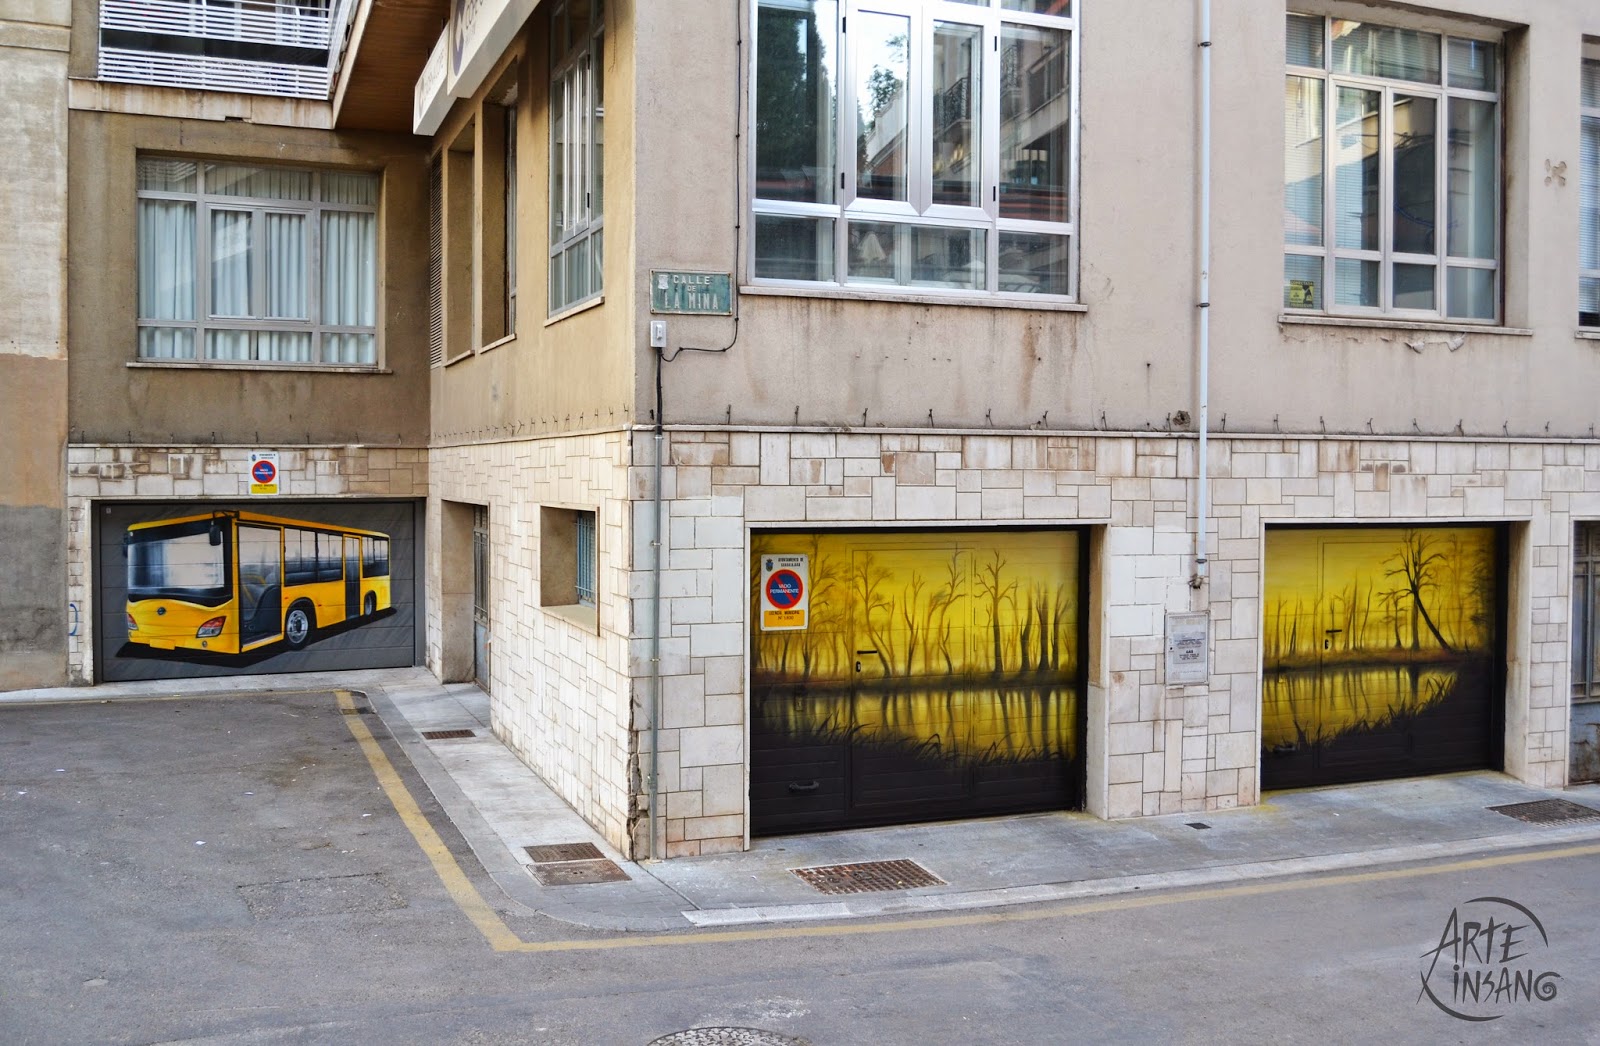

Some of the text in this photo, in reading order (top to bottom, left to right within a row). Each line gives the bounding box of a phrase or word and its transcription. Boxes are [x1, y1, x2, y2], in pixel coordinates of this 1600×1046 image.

[673, 274, 711, 285] CALLE
[664, 293, 719, 310] LA MINA
